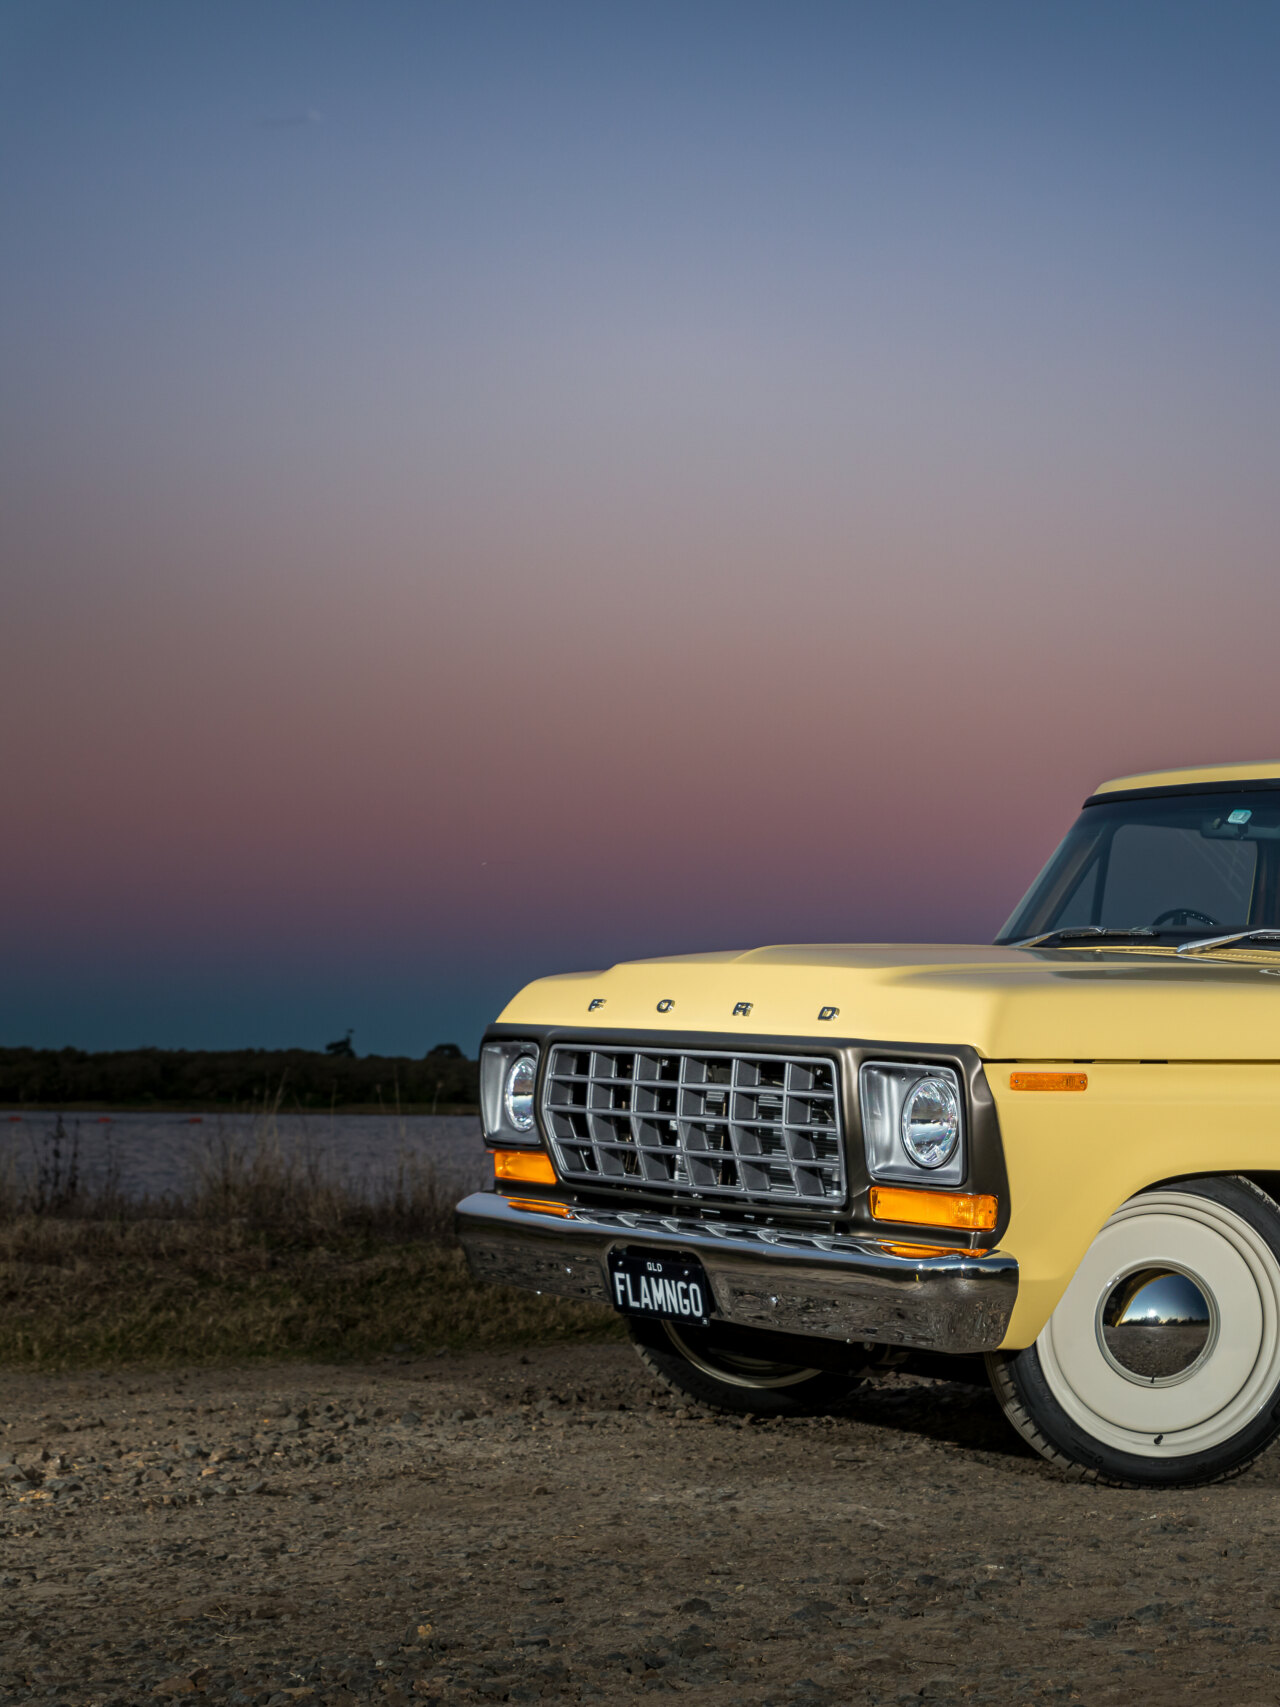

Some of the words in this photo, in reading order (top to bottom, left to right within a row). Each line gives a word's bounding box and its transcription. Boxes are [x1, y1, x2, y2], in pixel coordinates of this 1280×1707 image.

[588, 998, 840, 1021] FORD
[646, 1261, 663, 1272] QLD
[613, 1271, 703, 1317] FLAMNGO
